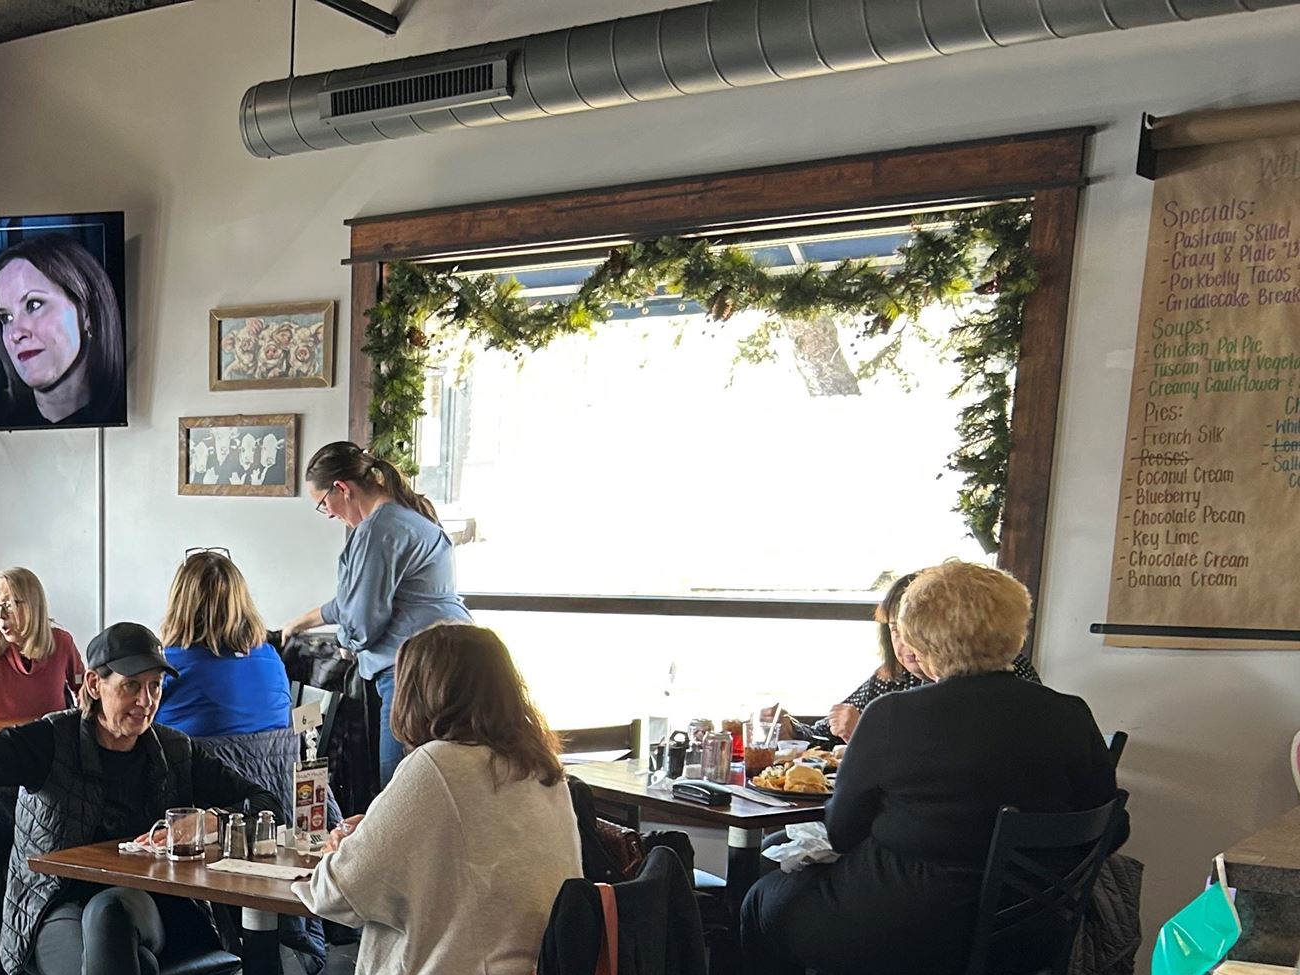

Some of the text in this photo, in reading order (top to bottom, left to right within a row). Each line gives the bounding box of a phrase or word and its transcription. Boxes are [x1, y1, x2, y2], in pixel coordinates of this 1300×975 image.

[1163, 199, 1255, 228] Specials:
[1173, 221, 1291, 250] Pastrami Skillet
[1171, 249, 1215, 271] Crazy
[1223, 246, 1233, 263] 8
[1240, 243, 1276, 263] Plate
[1170, 265, 1291, 292] Porkbelly Tacos
[1166, 290, 1250, 312] Griddlecake
[1152, 317, 1211, 341] Soups:
[1153, 334, 1262, 360] Chicken Pot Pie
[1152, 361, 1199, 378] Tuscan
[1206, 357, 1251, 376] Turkey
[1148, 379, 1200, 401] Creamy
[1204, 374, 1281, 394] Cauliflower
[1144, 401, 1184, 422] Pies:
[1142, 424, 1225, 446] French Silk
[1137, 466, 1234, 486] Coconut Cream
[1136, 488, 1201, 509] Blueberry
[1133, 505, 1245, 526] Chocolate Pecan
[1133, 530, 1200, 550] Key Lime
[1129, 550, 1249, 568] Chocolate Cream
[1128, 569, 1237, 588] Banana Cream
